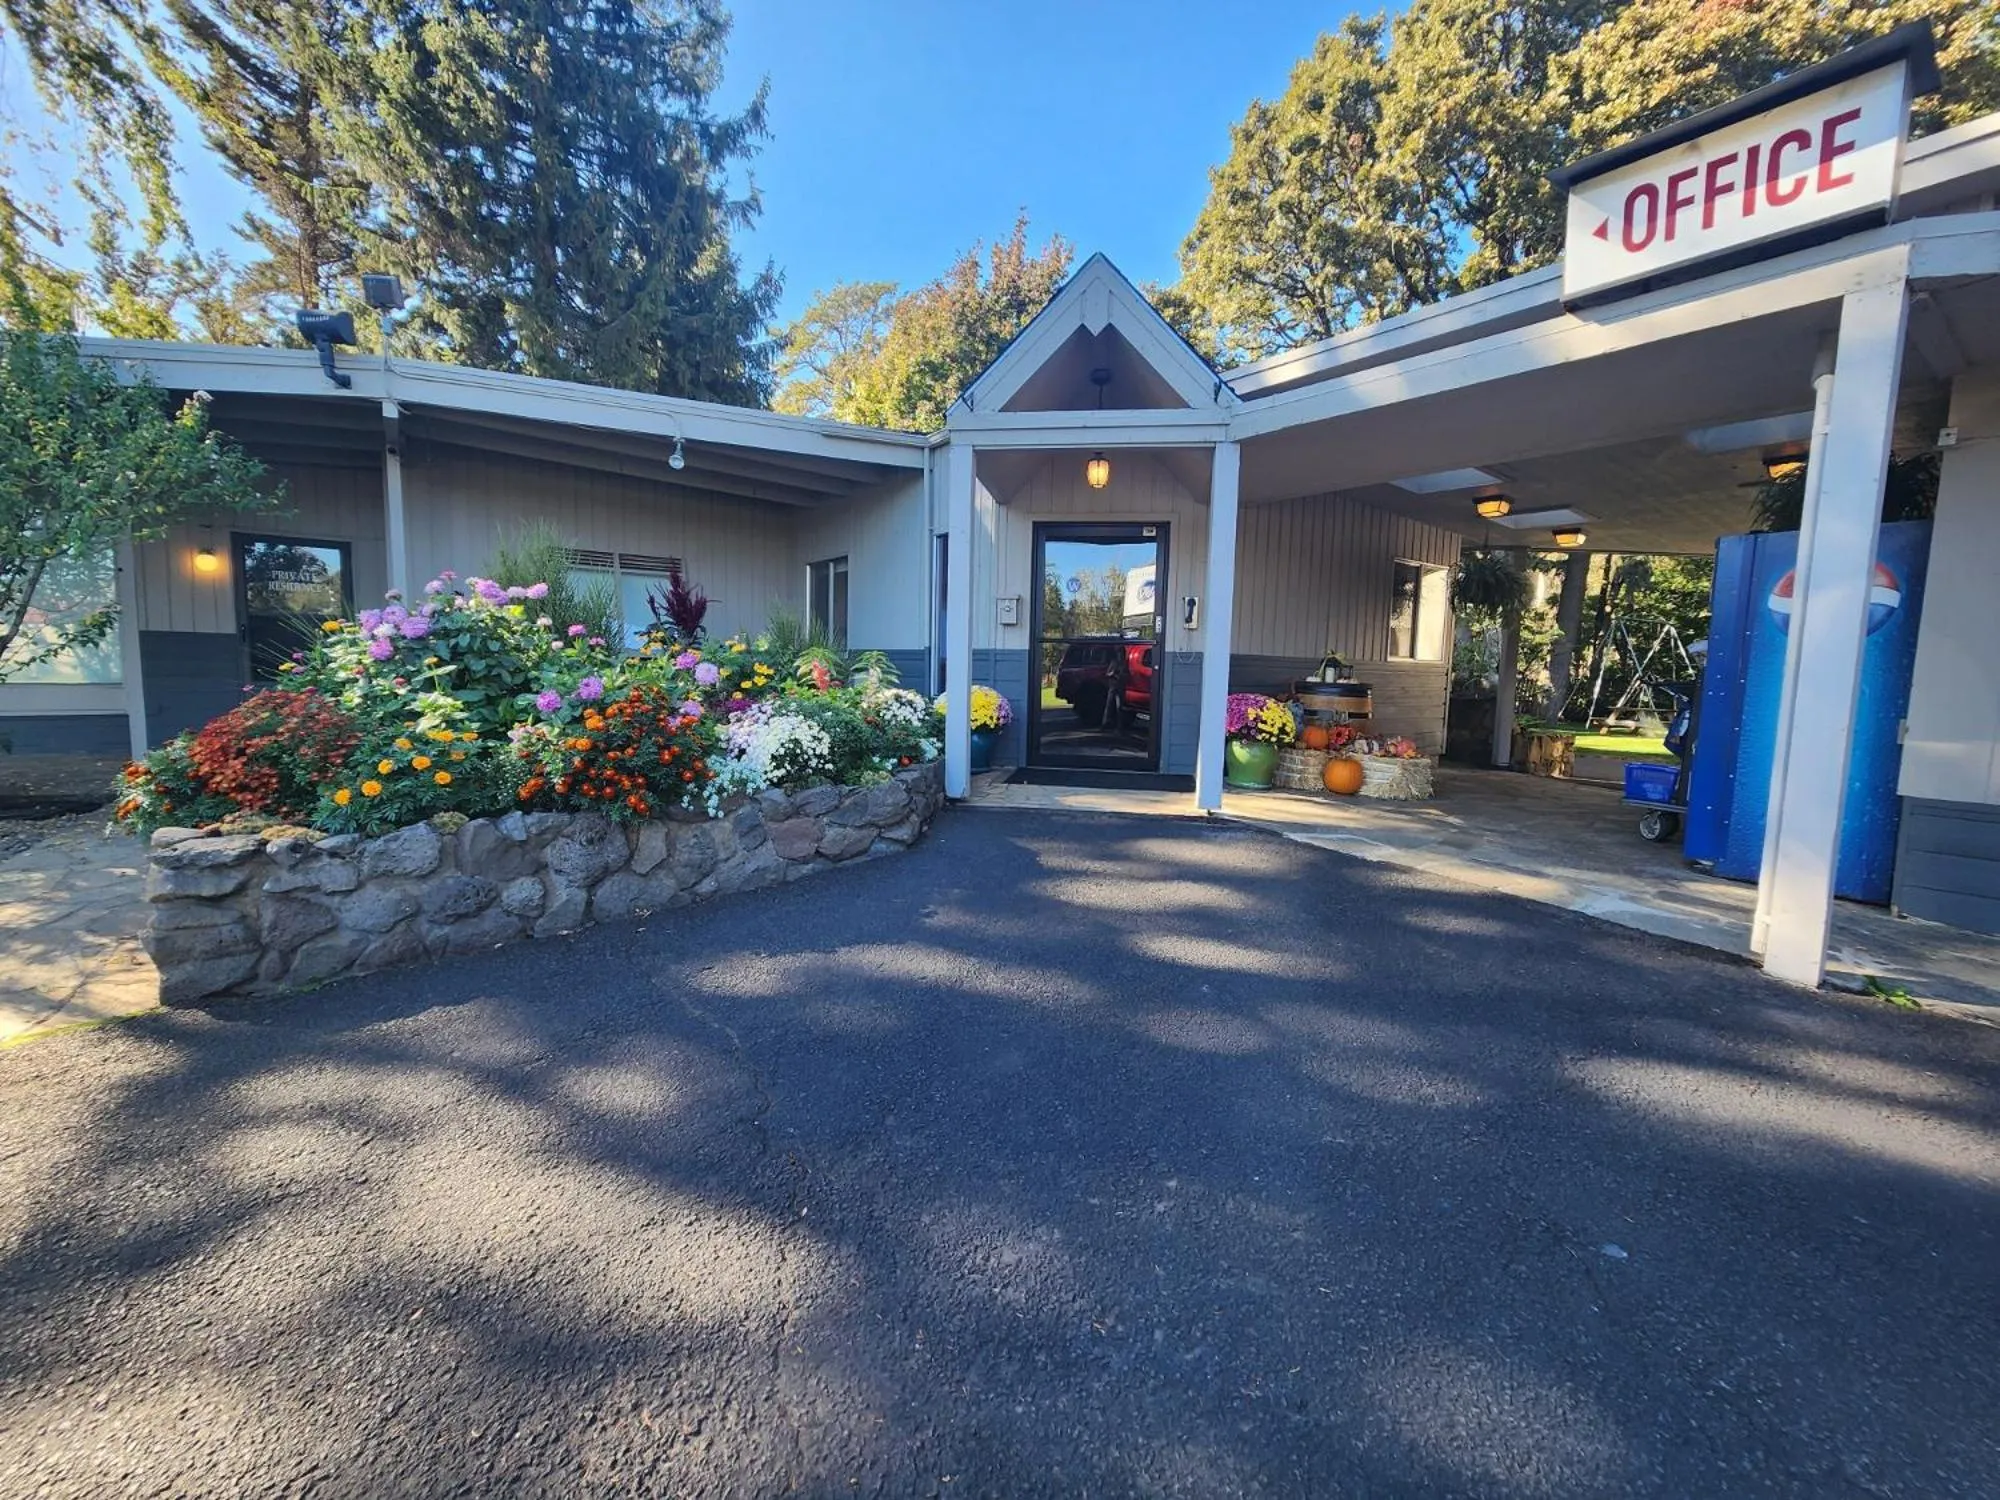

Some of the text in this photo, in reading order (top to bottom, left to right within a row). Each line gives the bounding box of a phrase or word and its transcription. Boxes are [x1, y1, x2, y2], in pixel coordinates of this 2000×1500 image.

[1623, 108, 1861, 252] OFFICE
[271, 571, 318, 581] PRIVATE
[268, 581, 321, 592] RESIDENCE
